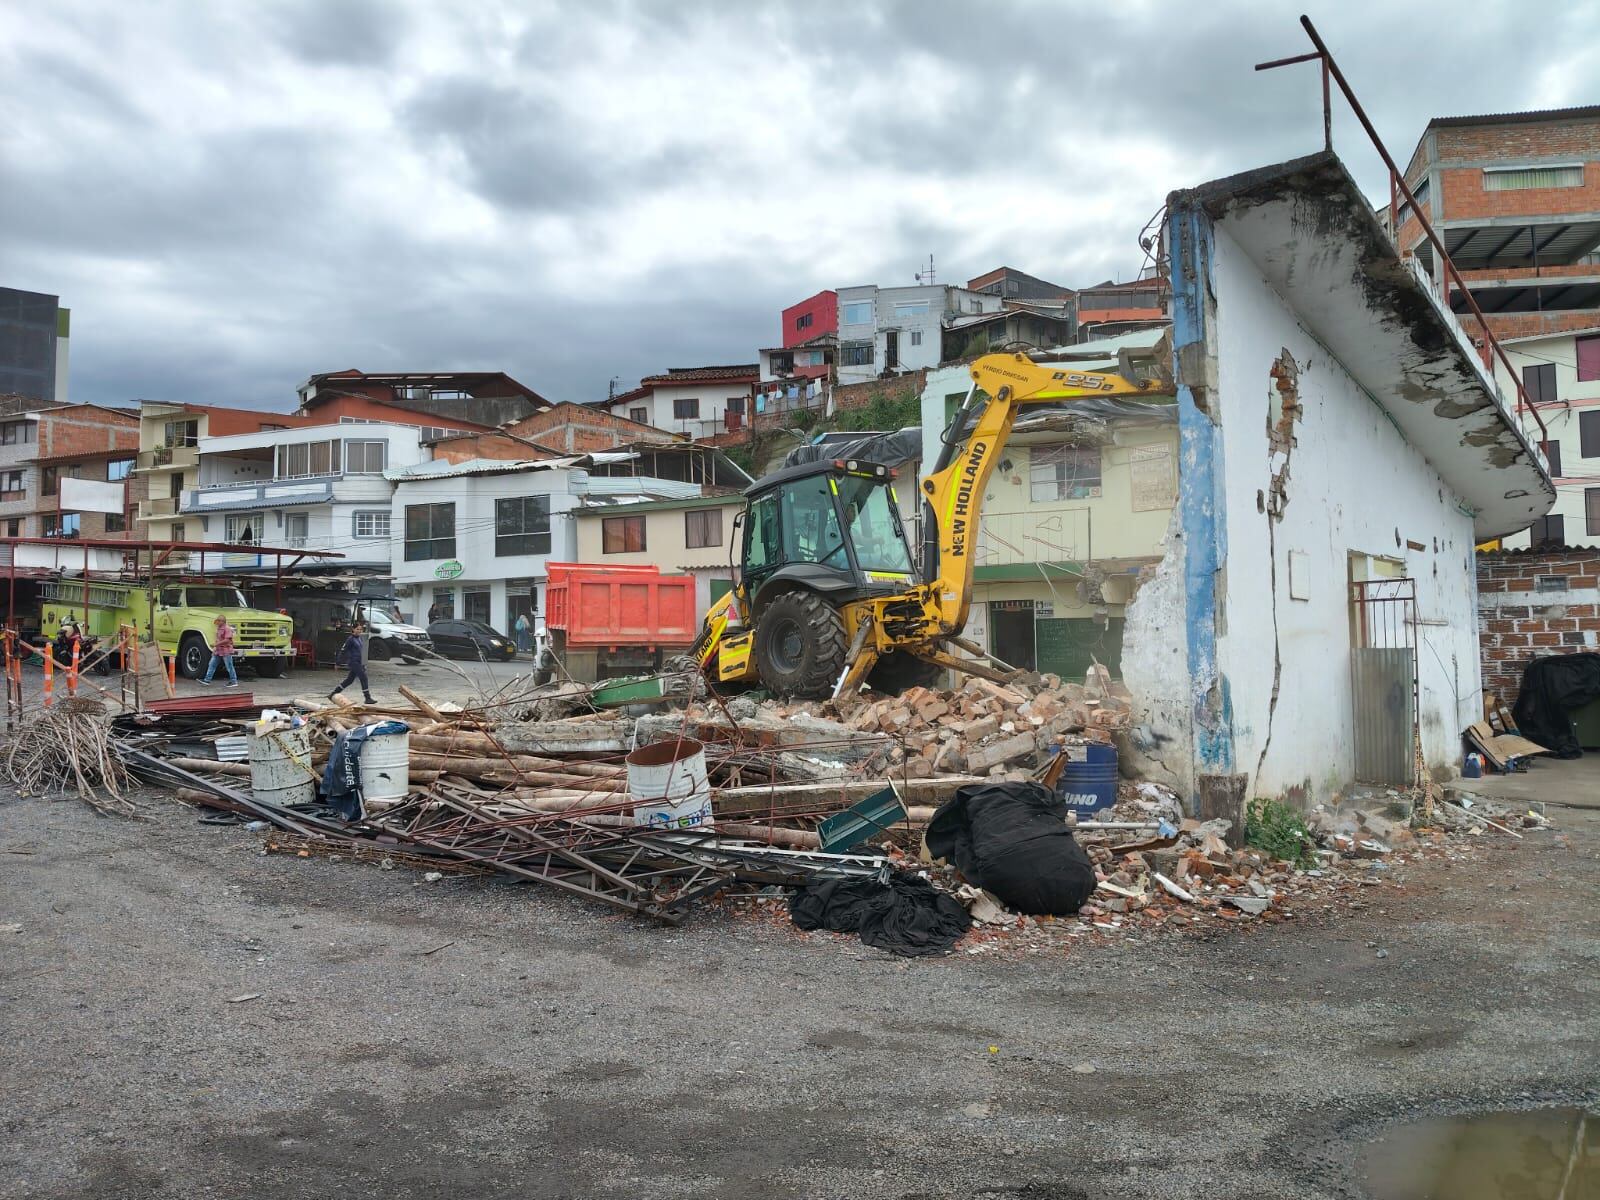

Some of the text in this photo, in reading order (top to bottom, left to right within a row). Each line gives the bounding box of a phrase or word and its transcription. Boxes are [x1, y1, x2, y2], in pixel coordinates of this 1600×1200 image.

[952, 441, 987, 557] NEW HOLLAND
[696, 637, 713, 662] LLAND
[1064, 792, 1098, 806] UNO
